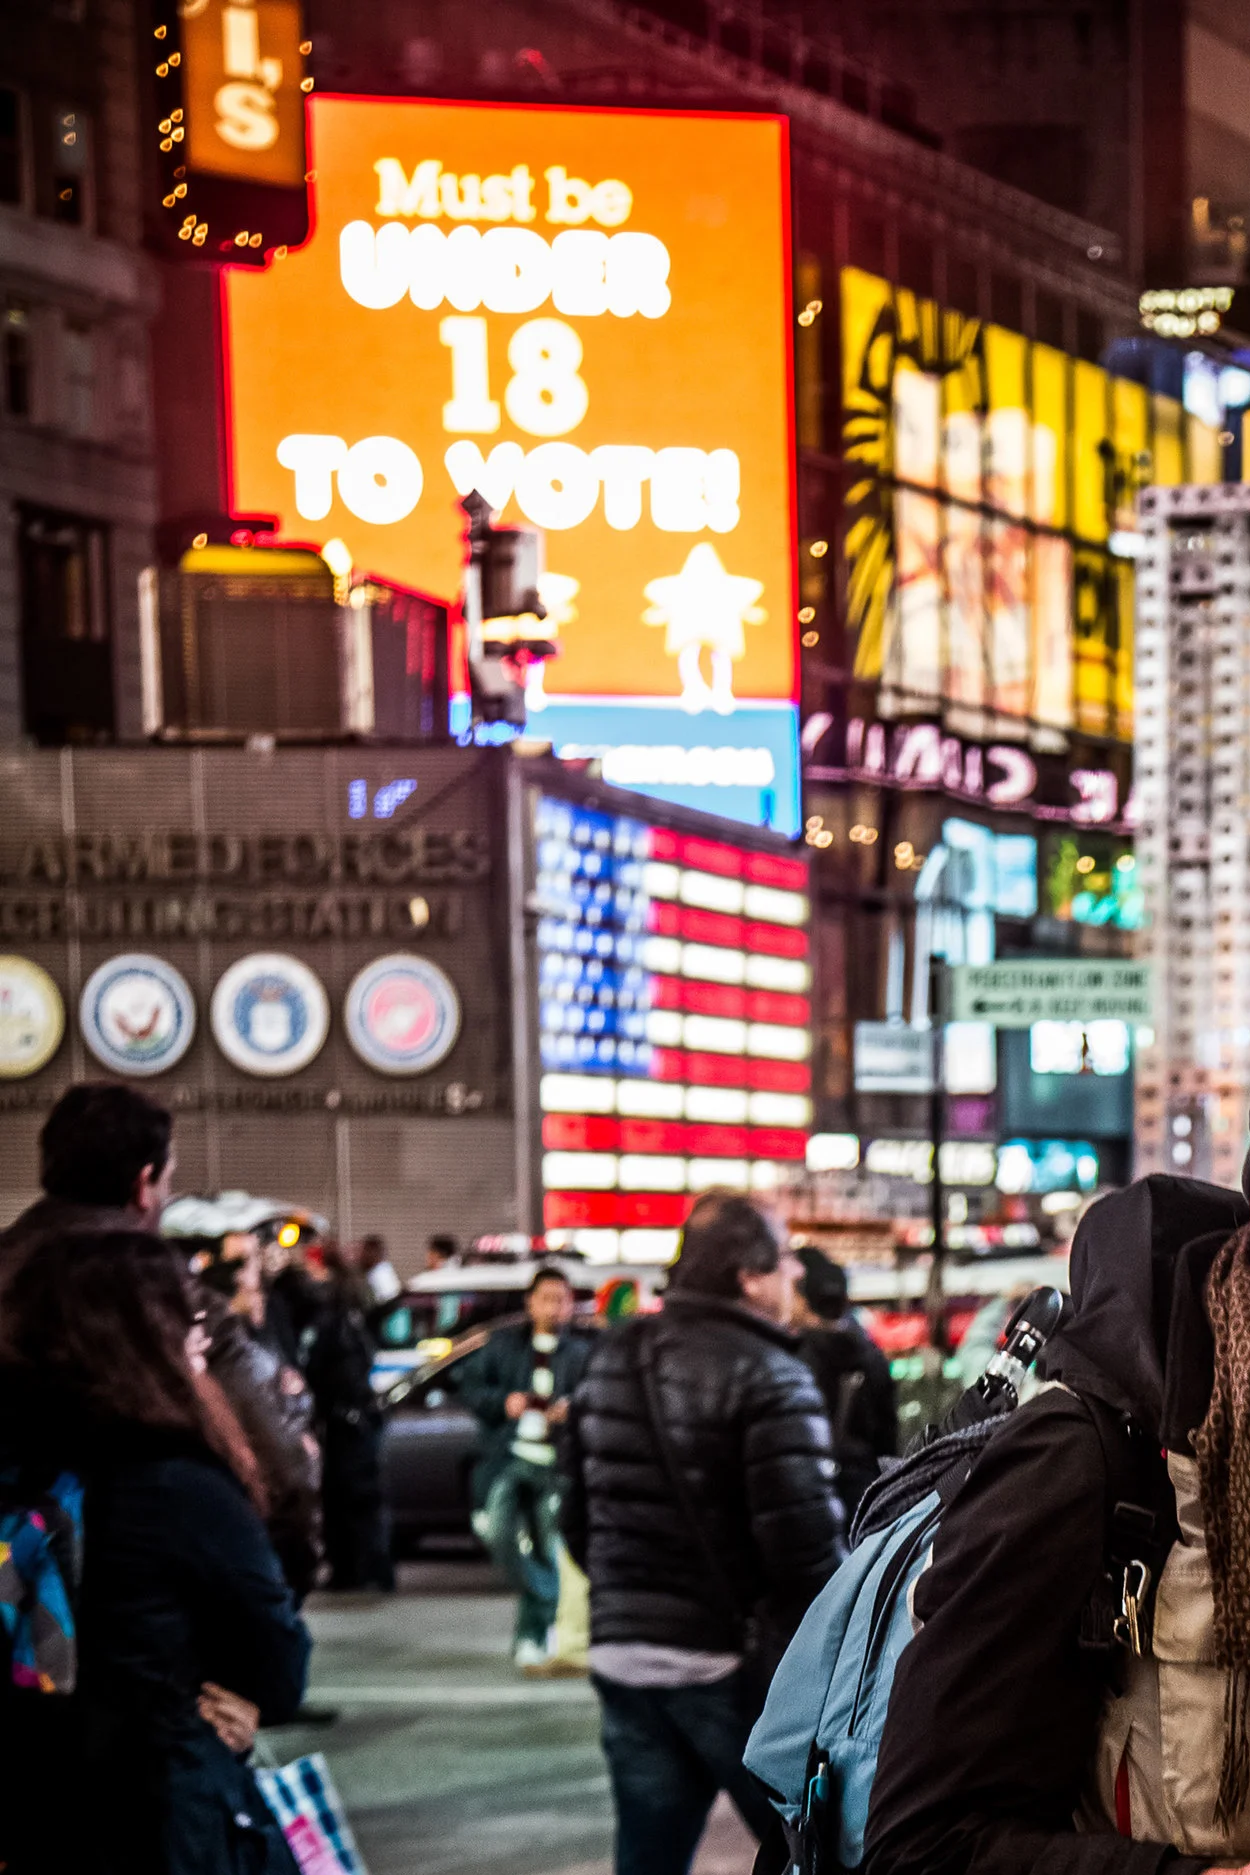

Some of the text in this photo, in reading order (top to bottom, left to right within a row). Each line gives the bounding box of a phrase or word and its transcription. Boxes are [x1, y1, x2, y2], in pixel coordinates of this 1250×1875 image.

[374, 157, 634, 227] Must be
[338, 220, 672, 319] UNDER
[439, 315, 590, 437] 18
[276, 433, 741, 534] TO VOTE!
[20, 829, 492, 879] ARMED FORCES
